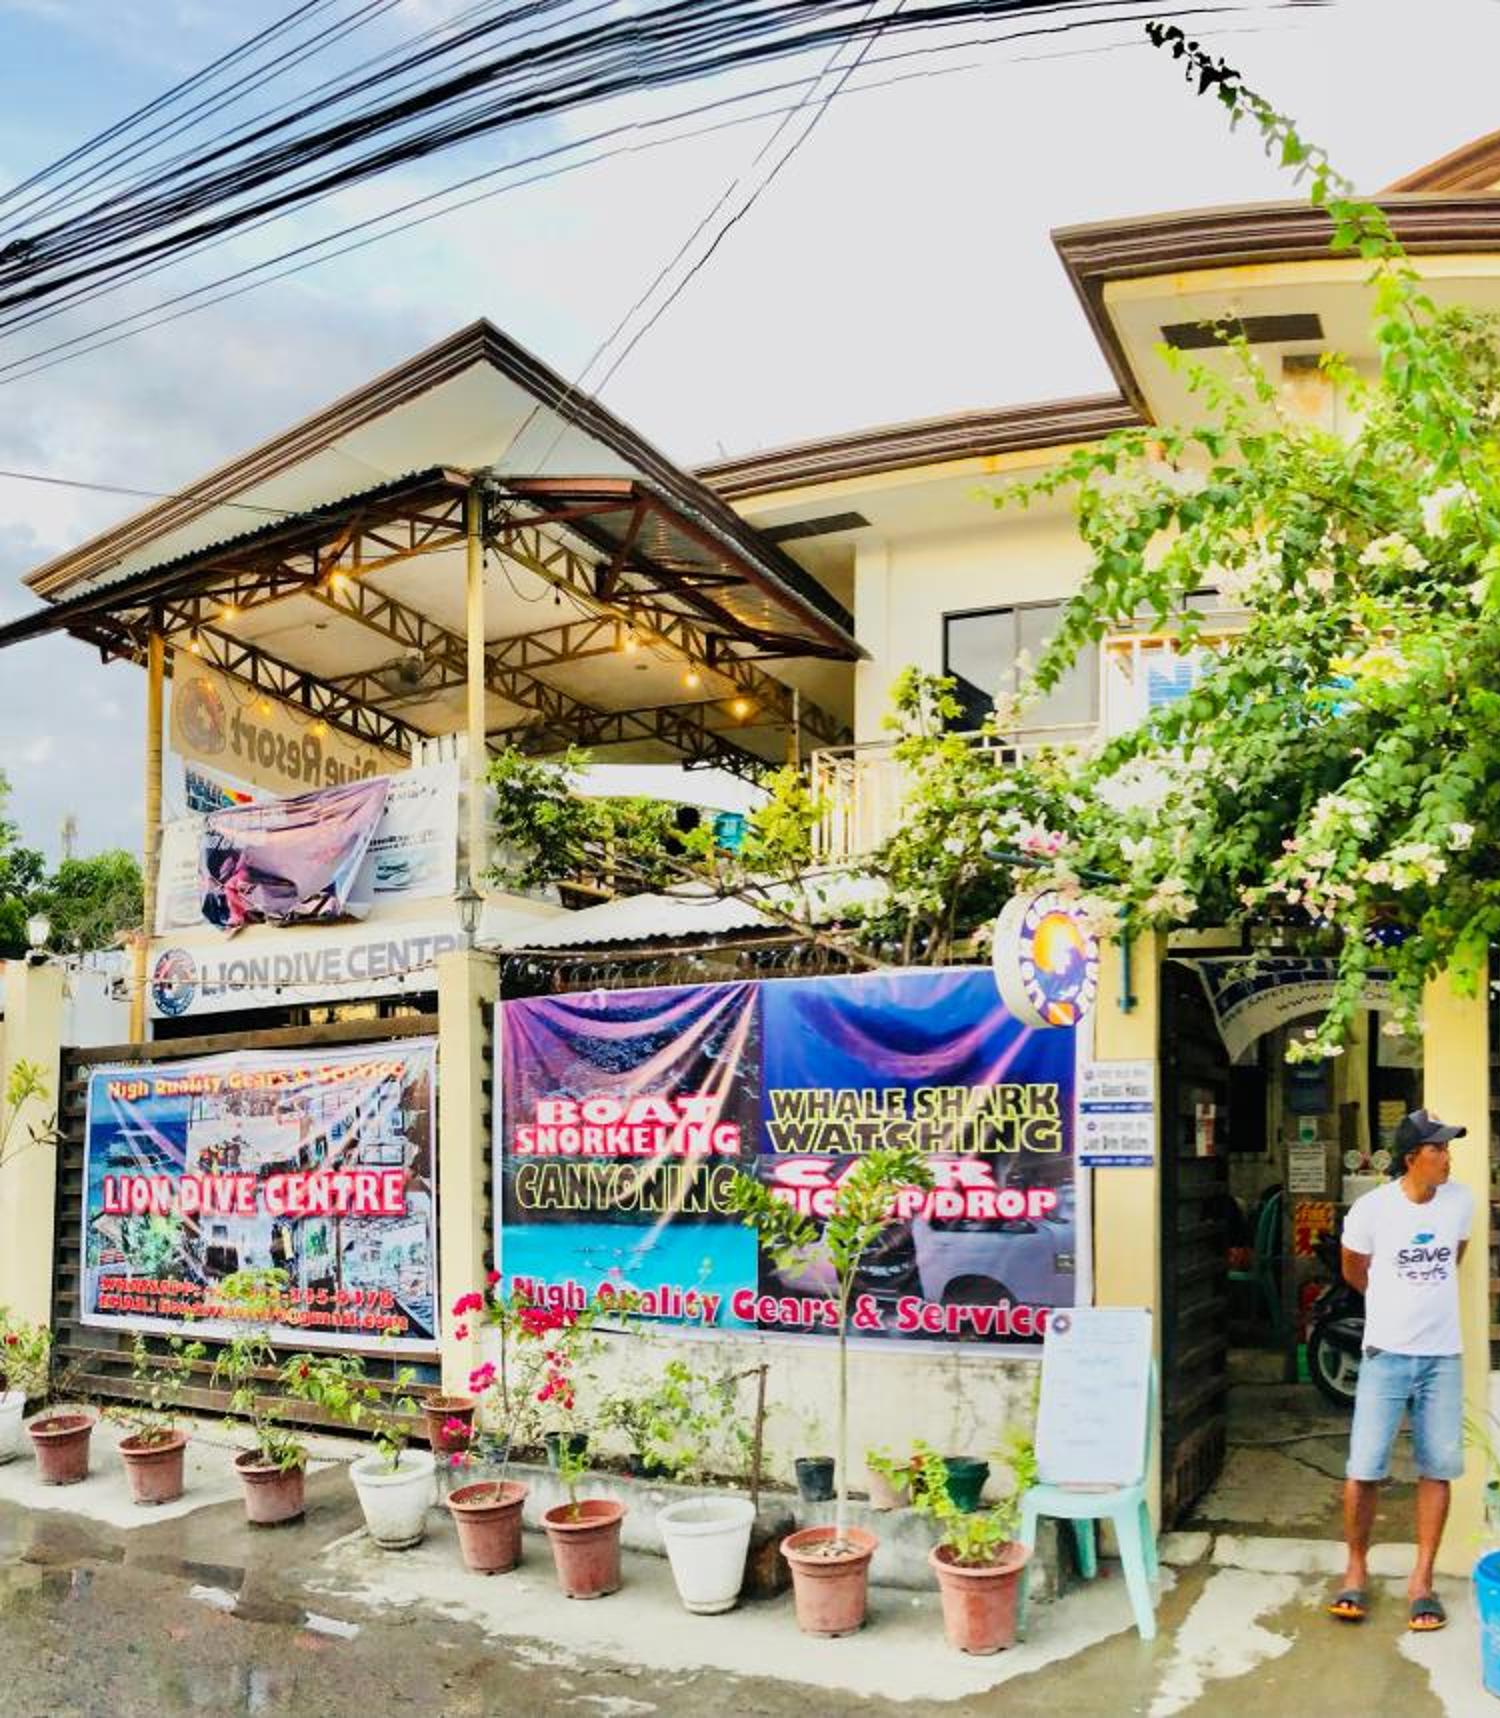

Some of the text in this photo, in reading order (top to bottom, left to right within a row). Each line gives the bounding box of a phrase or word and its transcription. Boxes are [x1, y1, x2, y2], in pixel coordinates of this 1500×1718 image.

[201, 957, 269, 997] LION
[274, 947, 343, 986] DIVE
[108, 1080, 149, 1101] High
[768, 1087, 907, 1121] WHALE
[912, 1083, 1060, 1119] SHARK
[534, 1093, 720, 1126] BOAT
[513, 1120, 741, 1157] SNORKELING
[766, 1117, 1063, 1153] WATCHING
[103, 1169, 407, 1218] LION DIVE CENTRE
[515, 1163, 739, 1213] CANYONING
[1397, 1245, 1452, 1266] save
[511, 1275, 587, 1311] High
[732, 1286, 841, 1329] Gears
[853, 1293, 885, 1331] &
